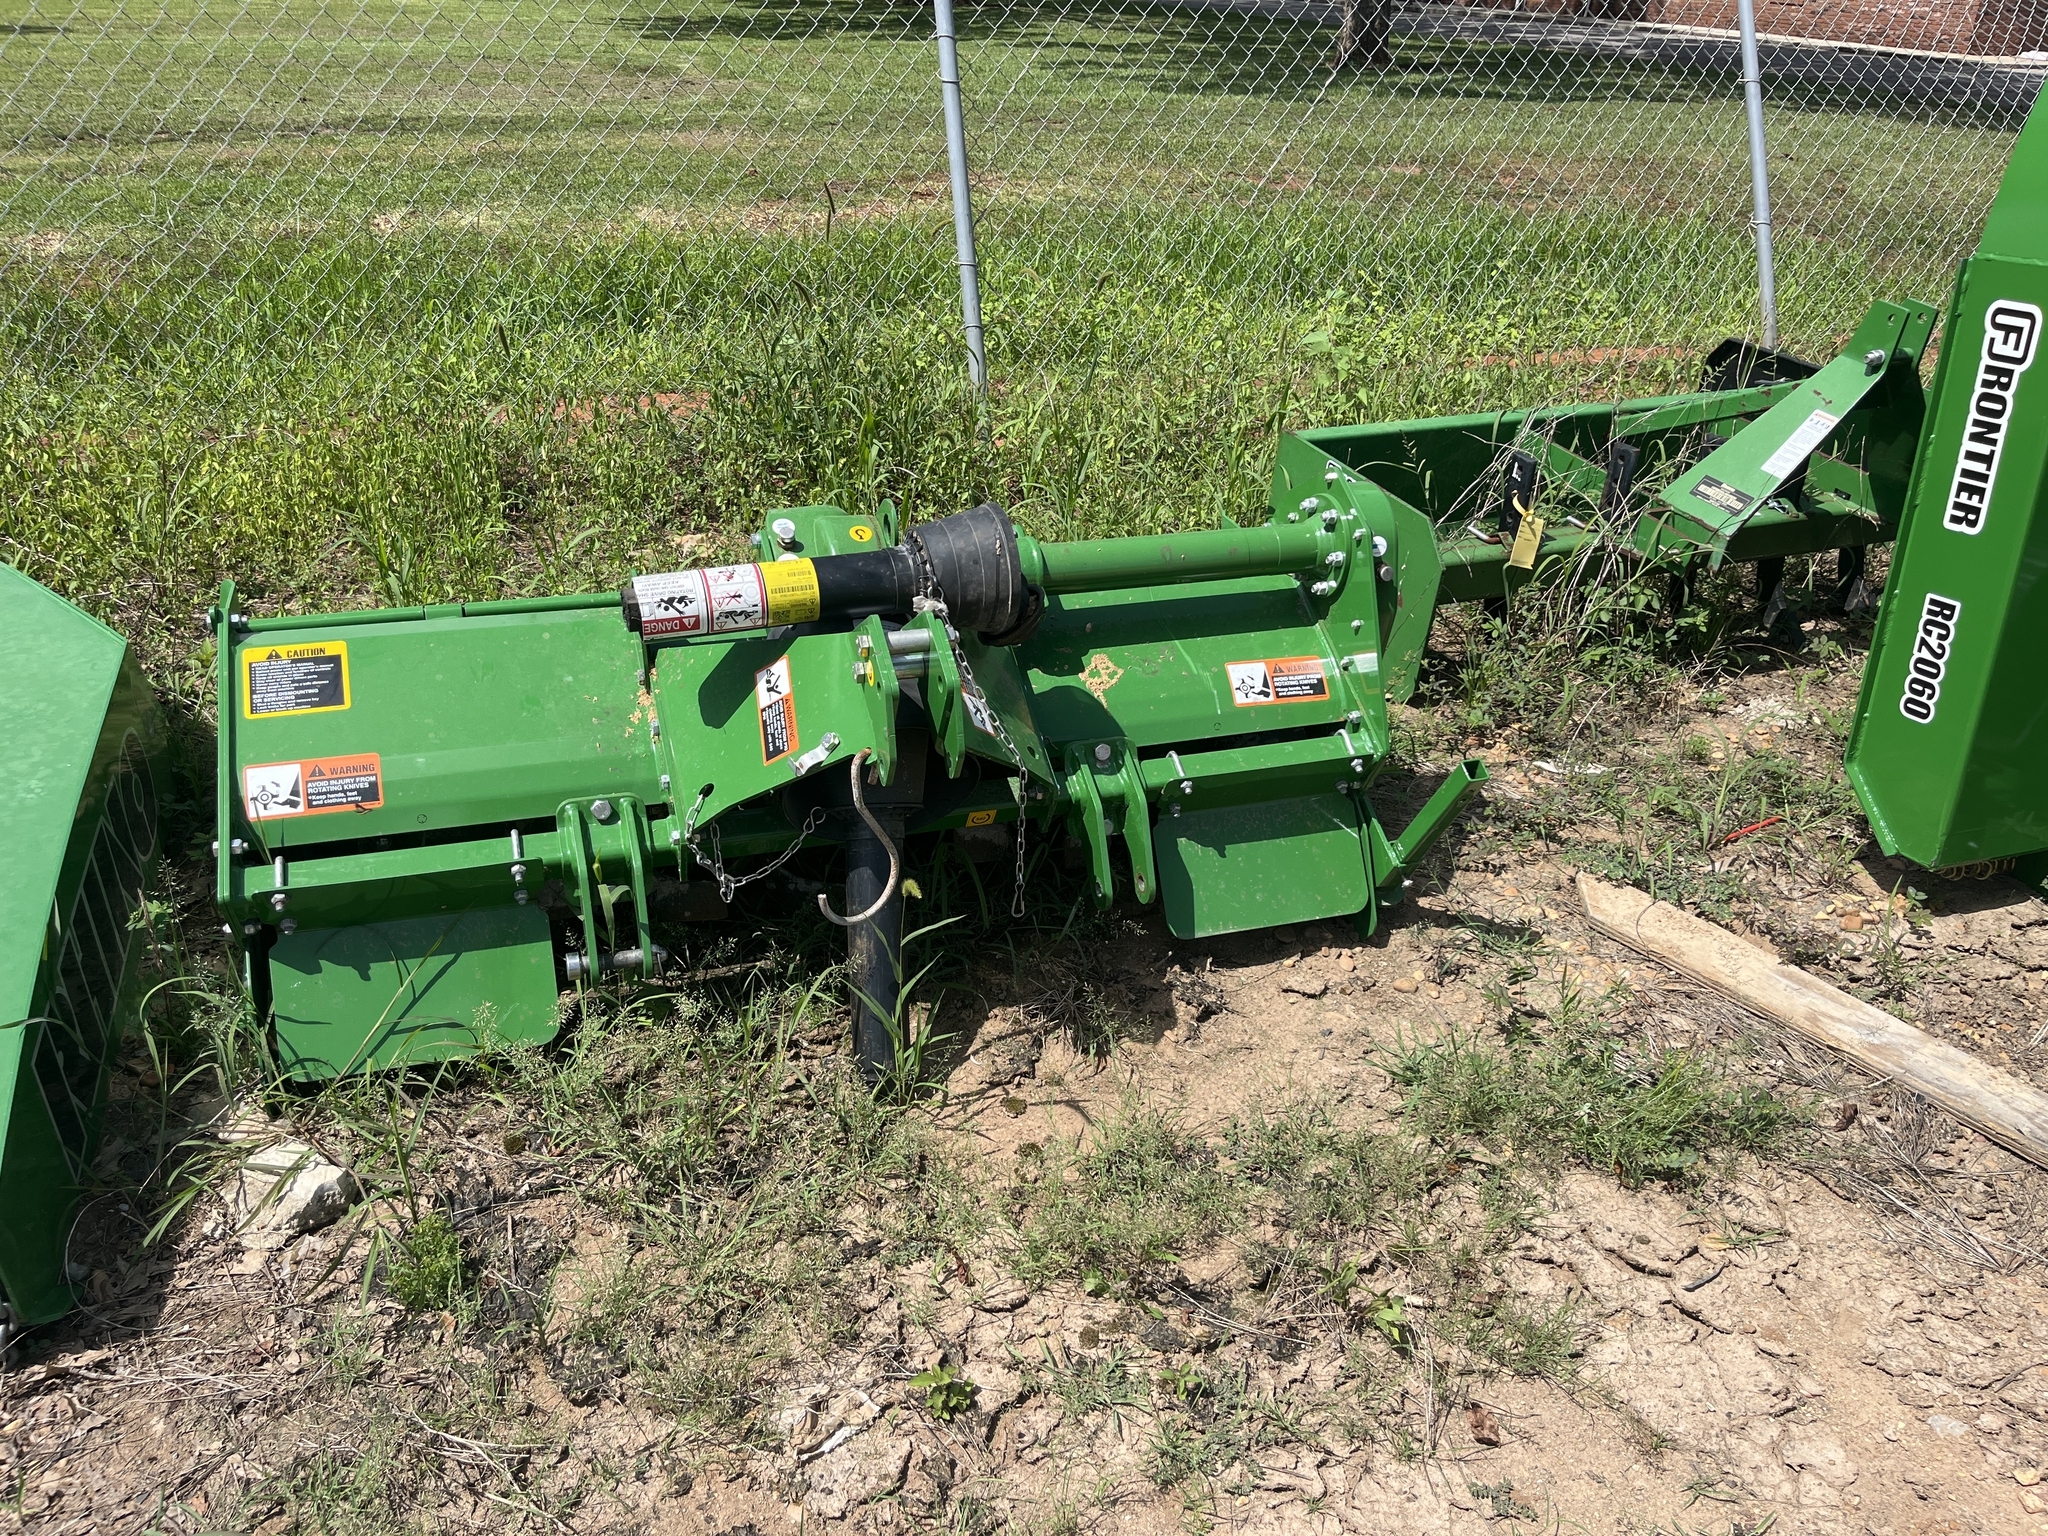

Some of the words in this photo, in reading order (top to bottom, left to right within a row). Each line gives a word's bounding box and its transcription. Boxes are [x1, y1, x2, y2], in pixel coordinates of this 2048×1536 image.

[1949, 307, 2036, 529] FRONTIER
[644, 620, 679, 633] DANGE
[287, 648, 325, 658] CAUTION
[1903, 597, 1956, 720] RC2060
[1286, 664, 1318, 673] WARNING
[785, 705, 795, 742] WARNING
[330, 764, 375, 775] WARNING
[308, 780, 328, 788] AVOID
[344, 782, 369, 790] KNIVES
